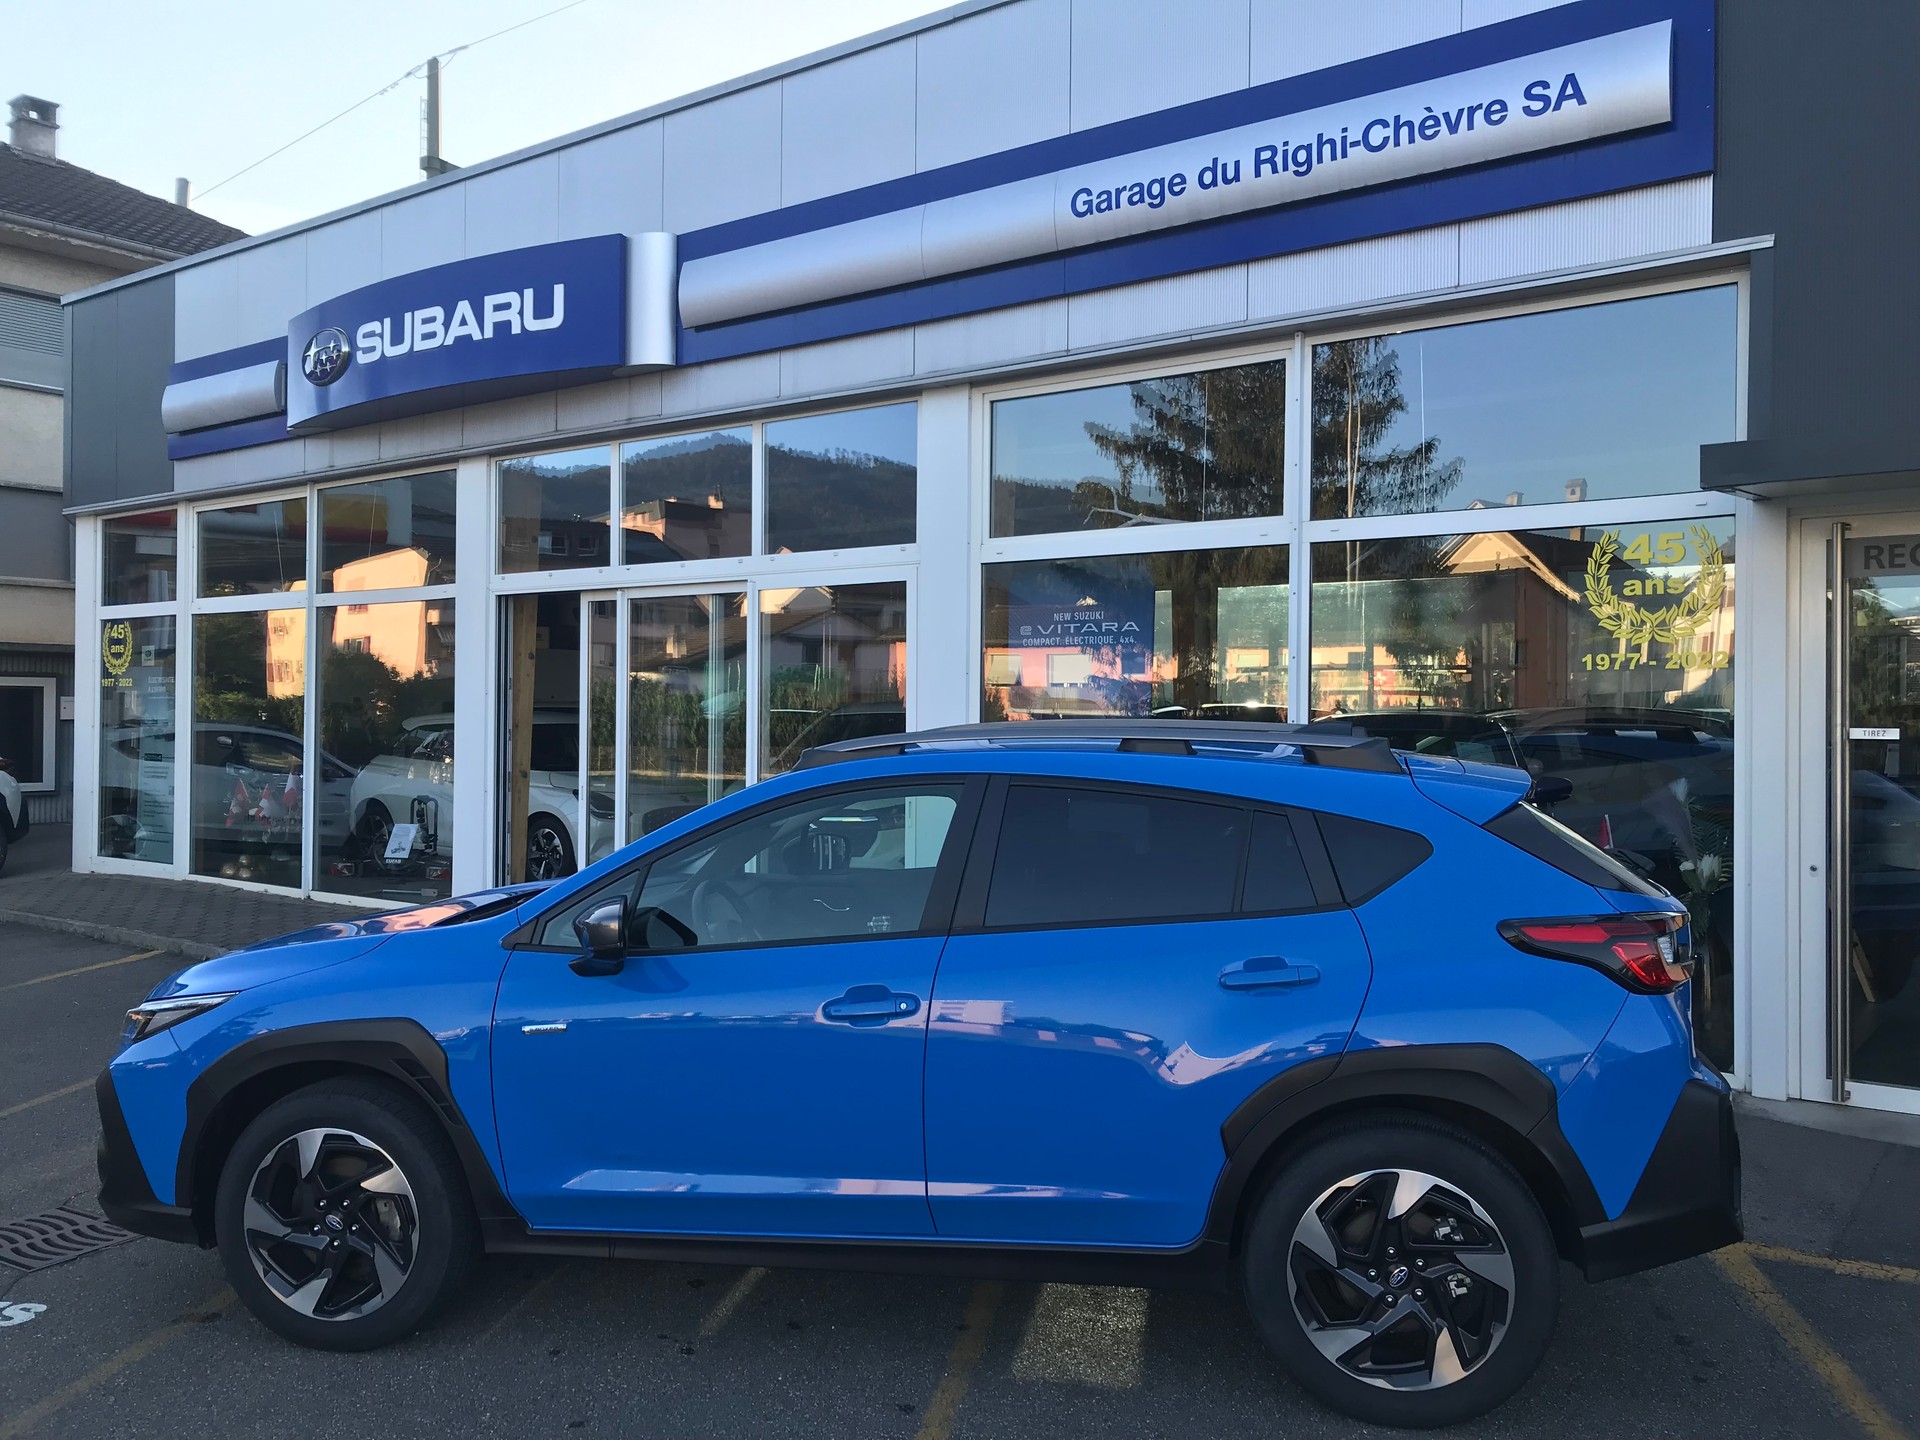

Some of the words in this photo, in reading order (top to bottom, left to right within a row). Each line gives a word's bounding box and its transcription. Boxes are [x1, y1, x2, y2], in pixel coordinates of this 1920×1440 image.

[1070, 171, 1187, 218] Garage
[1197, 156, 1241, 190] du
[1253, 98, 1509, 178] Righi-Chèvre
[1521, 72, 1588, 118] SA
[356, 283, 565, 365] SUBARU
[1623, 531, 1686, 565] 45
[1623, 577, 1686, 596] ans
[1053, 612, 1072, 621] NEW
[1074, 611, 1104, 621] SUZUKI
[111, 625, 124, 639] 45
[1037, 621, 1140, 635] VITARA
[1022, 638, 1062, 647] COMPACT.
[1065, 635, 1117, 646] ÉLECTRIQUE.
[111, 645, 124, 653] ans
[1581, 652, 1641, 671] 1977
[1664, 650, 1729, 670] 2022
[102, 679, 114, 687] 1977
[119, 678, 132, 687] 2022
[1862, 729, 1887, 737] TIREZ
